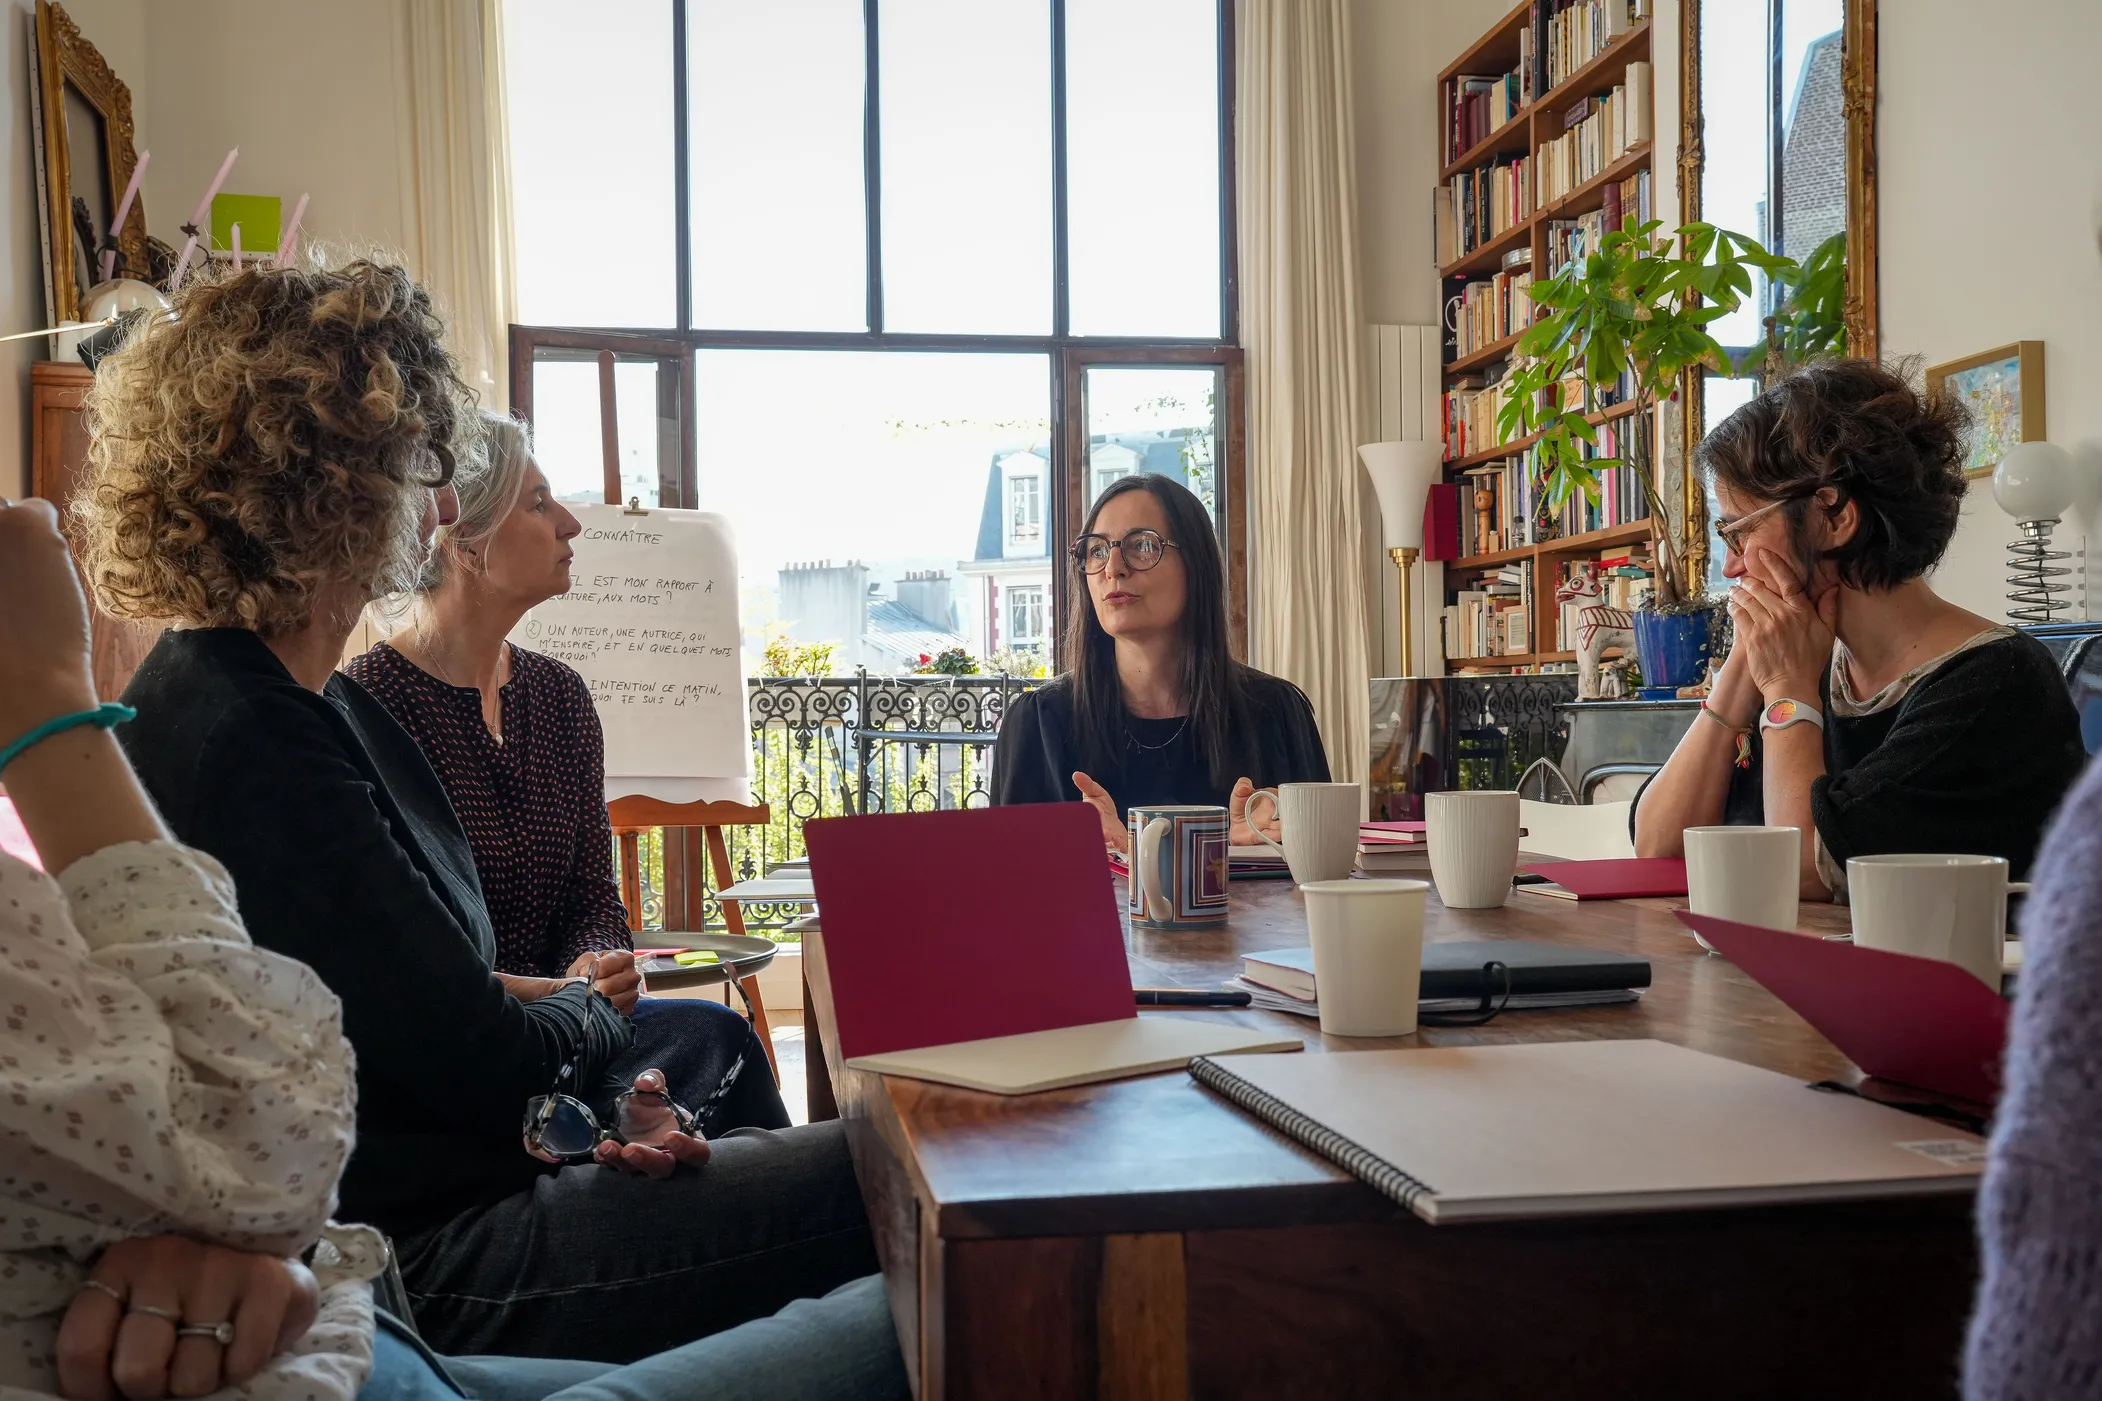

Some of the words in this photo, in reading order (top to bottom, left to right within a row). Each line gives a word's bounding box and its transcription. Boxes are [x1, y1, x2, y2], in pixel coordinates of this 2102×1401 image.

[593, 575, 618, 588] EST
[624, 578, 648, 588] MON
[656, 578, 699, 591] RAPPORT
[704, 580, 714, 593] À
[602, 592, 624, 603] AUX
[630, 594, 661, 605] MOTS
[547, 624, 567, 636] UN
[571, 627, 614, 639] AUTEUR,
[616, 628, 636, 638] UNE
[604, 642, 621, 650] ET
[628, 642, 645, 652] EN
[649, 643, 706, 655] QUELQUES
[661, 684, 676, 693] CE
[621, 694, 636, 704] JE
[642, 695, 665, 704] SUIS
[674, 697, 685, 707] LÀ
